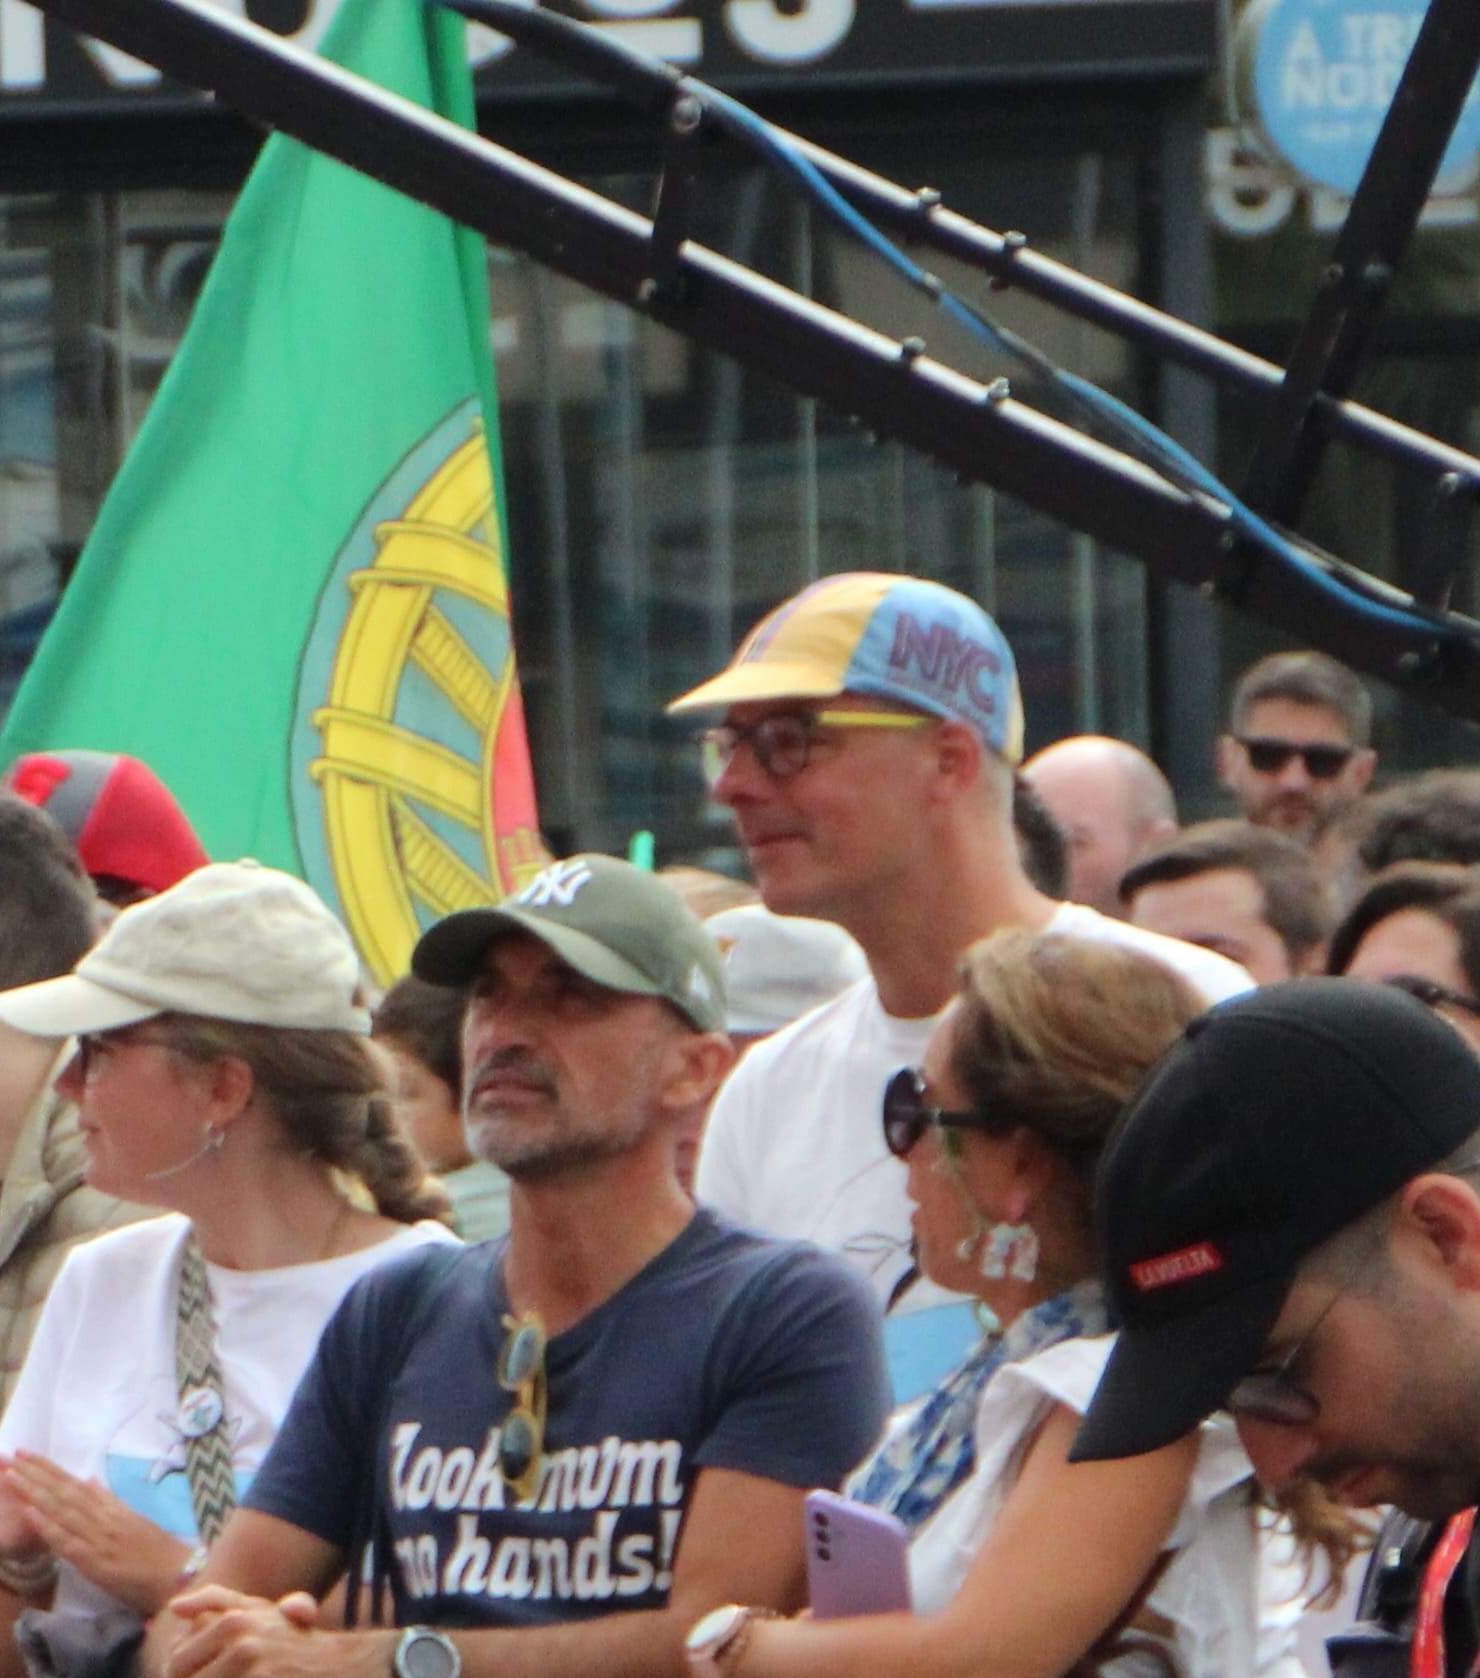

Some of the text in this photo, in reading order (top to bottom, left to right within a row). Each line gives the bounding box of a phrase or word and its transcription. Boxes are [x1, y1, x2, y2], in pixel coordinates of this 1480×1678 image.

[888, 610, 1001, 716] NYC
[532, 1437, 683, 1510] mum
[443, 1509, 679, 1600] hands!
